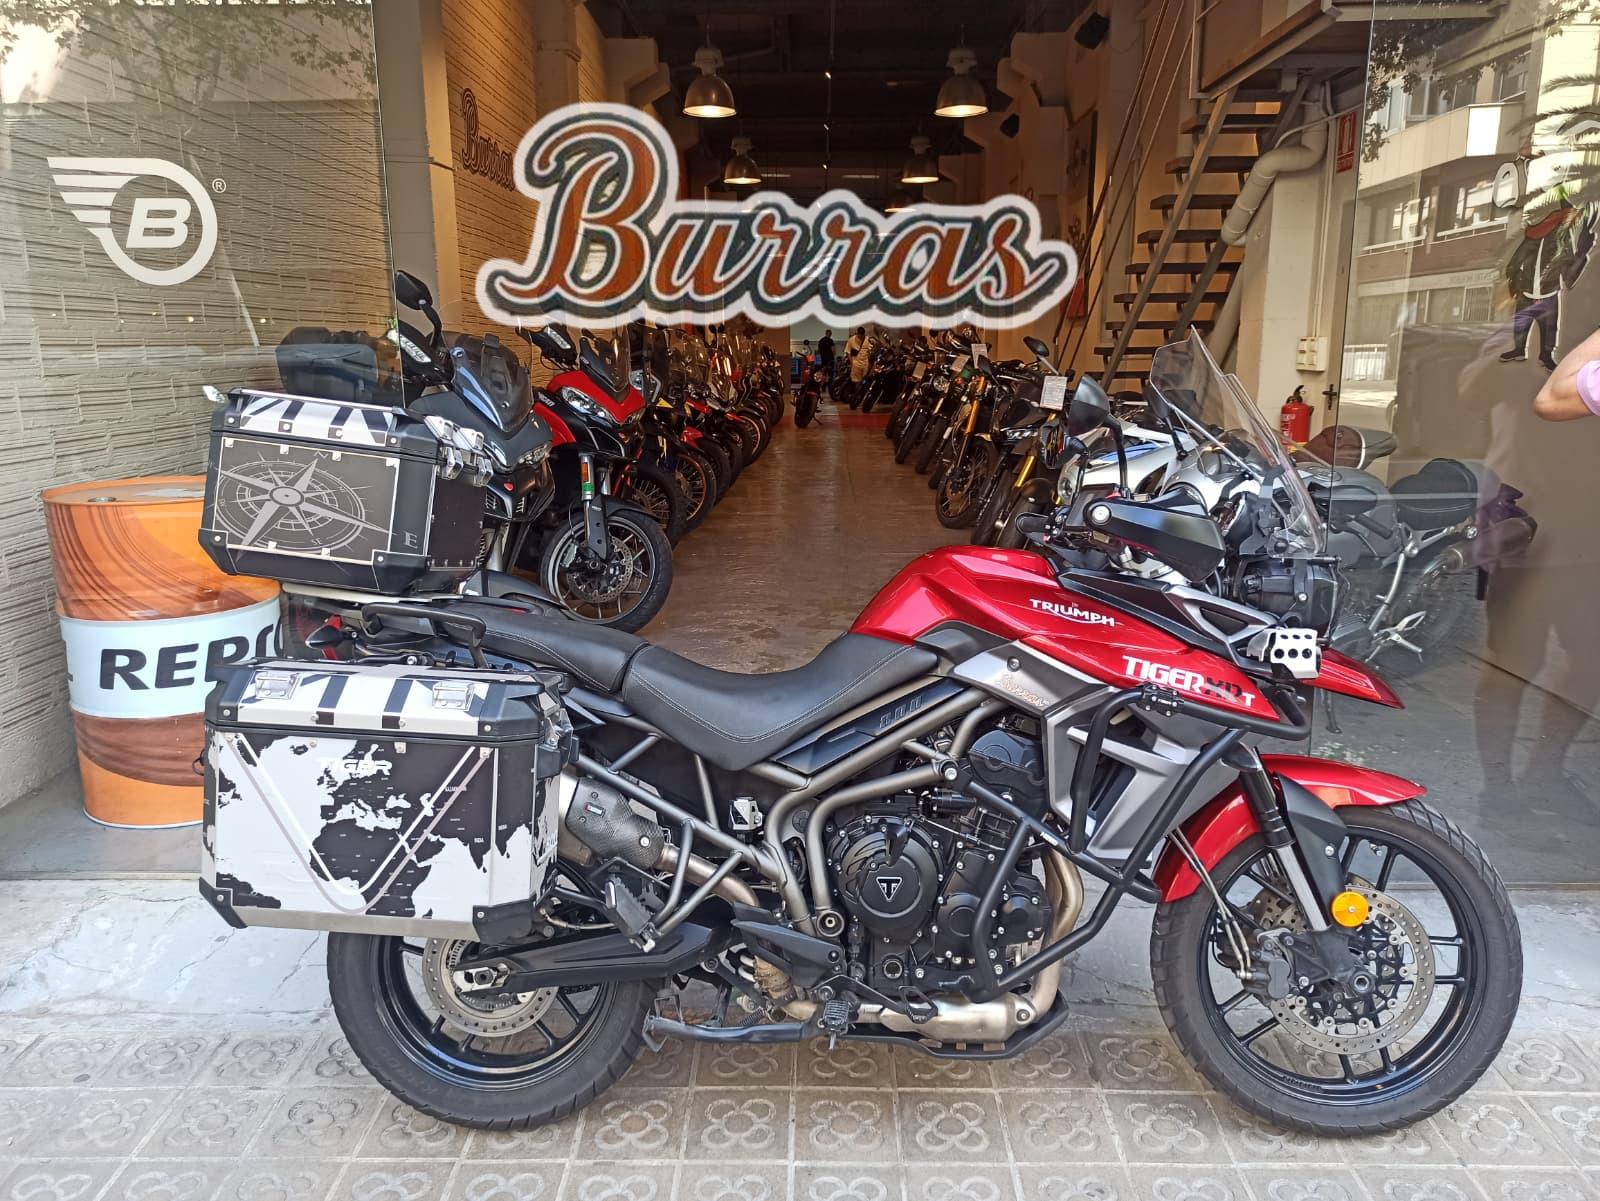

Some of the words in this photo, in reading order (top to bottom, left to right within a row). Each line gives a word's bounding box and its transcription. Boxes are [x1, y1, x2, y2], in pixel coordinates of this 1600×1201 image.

[462, 87, 516, 191] Burra
[482, 107, 1071, 325] Burras
[403, 531, 418, 549] E
[1029, 598, 1115, 627] TRIUMPH
[99, 618, 282, 691] REP
[1122, 655, 1204, 695] TIGER
